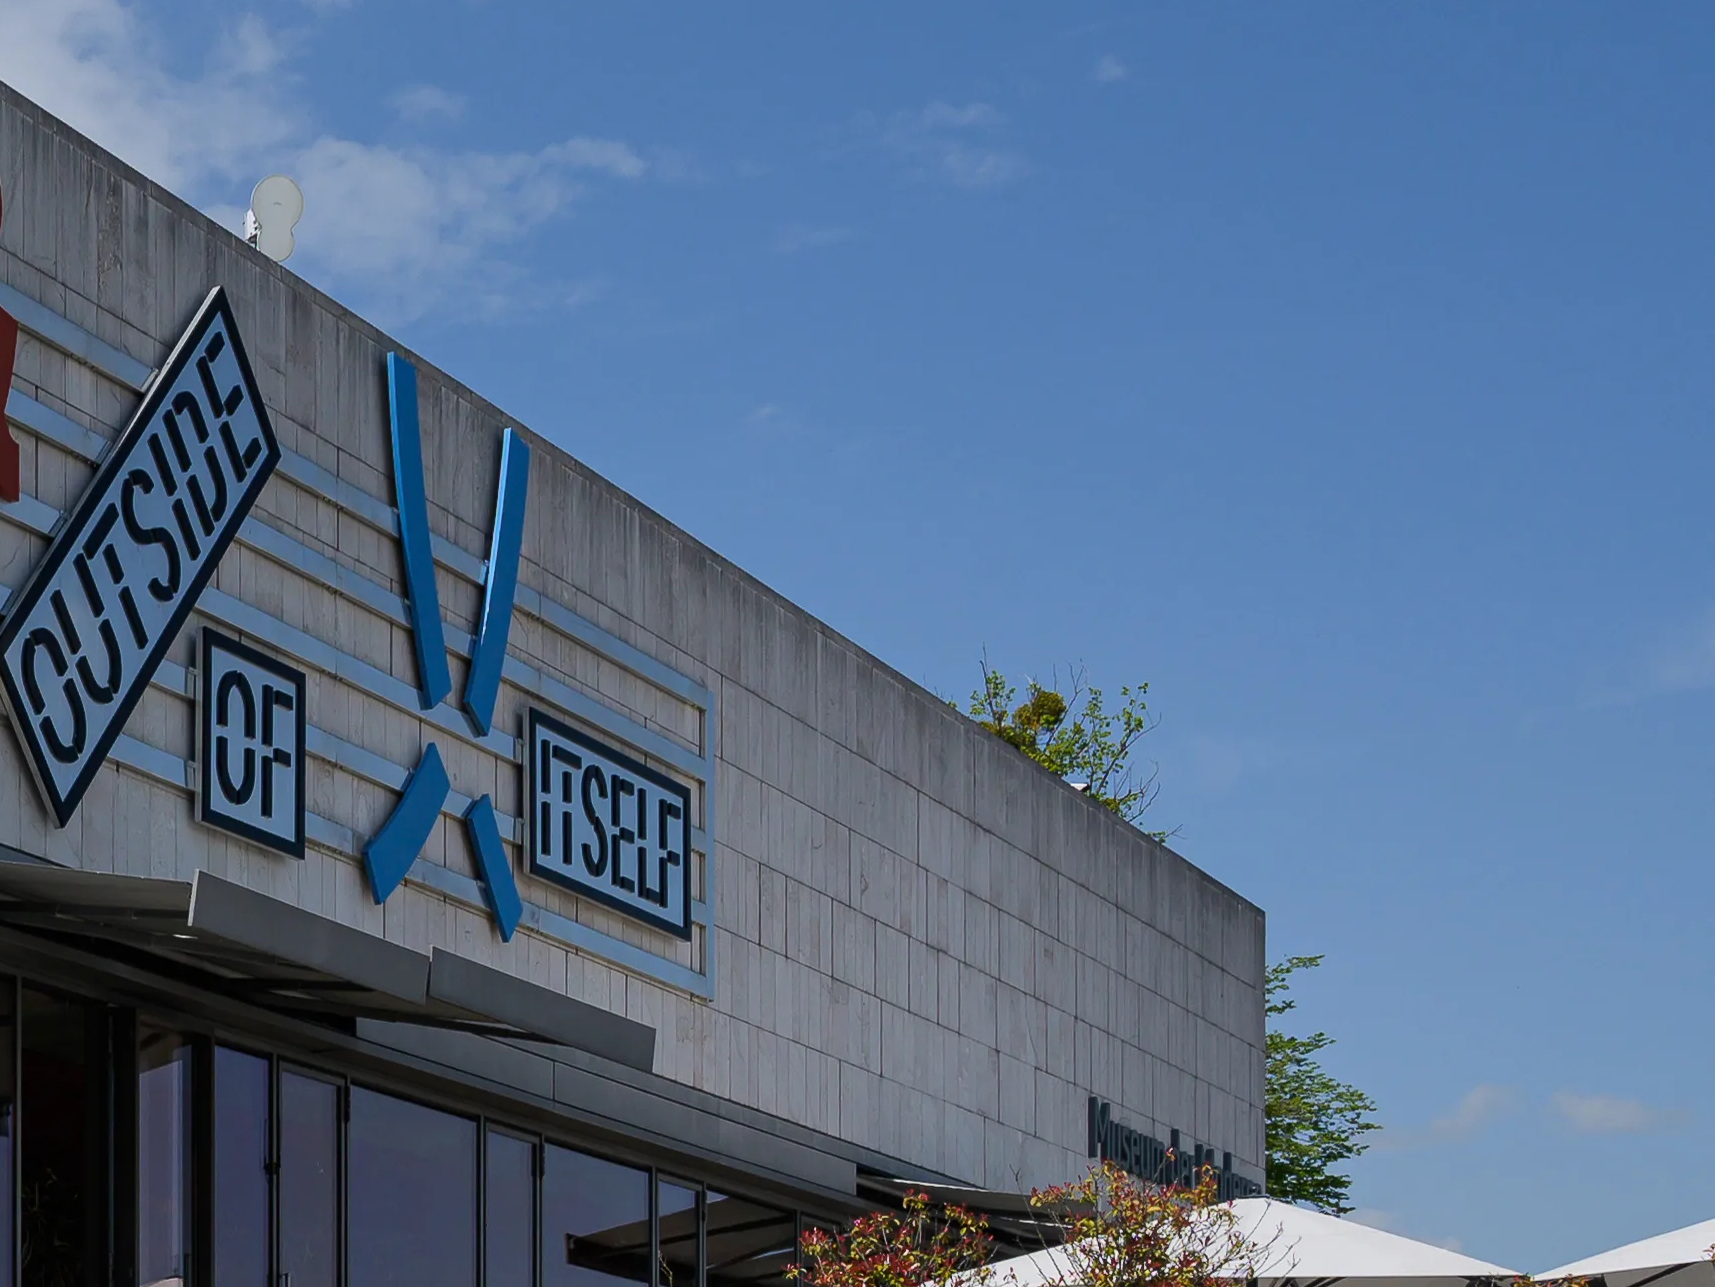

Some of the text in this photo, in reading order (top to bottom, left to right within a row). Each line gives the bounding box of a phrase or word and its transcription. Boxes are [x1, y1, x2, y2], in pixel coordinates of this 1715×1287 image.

[20, 331, 263, 765] OUTSIDE
[215, 669, 295, 819] OF
[539, 739, 683, 909] ITSELF
[1088, 1096, 1166, 1185] Museum
